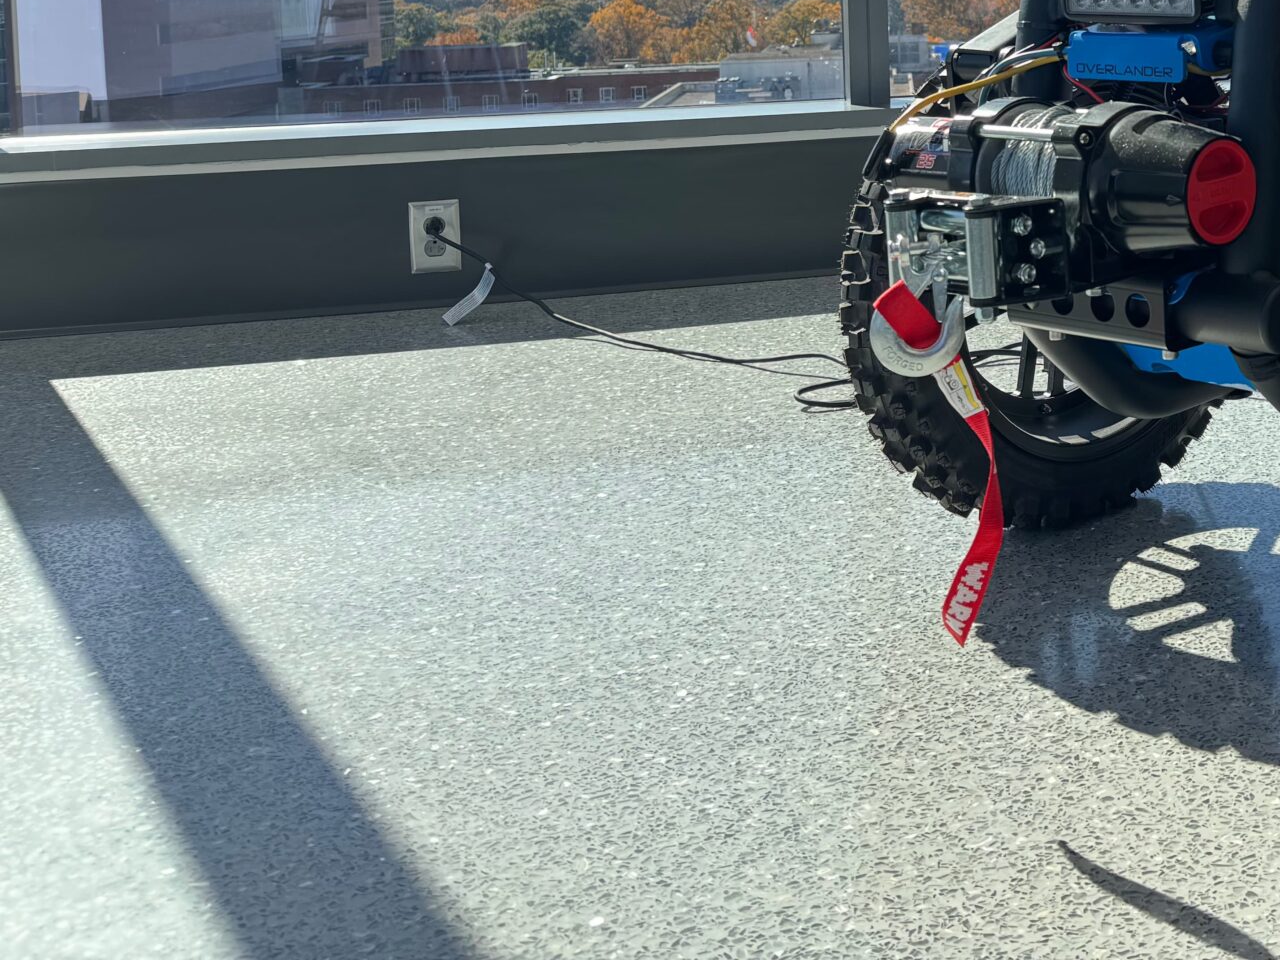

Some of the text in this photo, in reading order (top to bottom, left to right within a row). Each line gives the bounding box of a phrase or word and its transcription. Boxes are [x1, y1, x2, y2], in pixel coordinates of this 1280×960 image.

[1076, 62, 1173, 78] OVERLANDER
[916, 153, 937, 169] 25
[883, 345, 924, 372] FORGED
[945, 562, 989, 636] WARN
